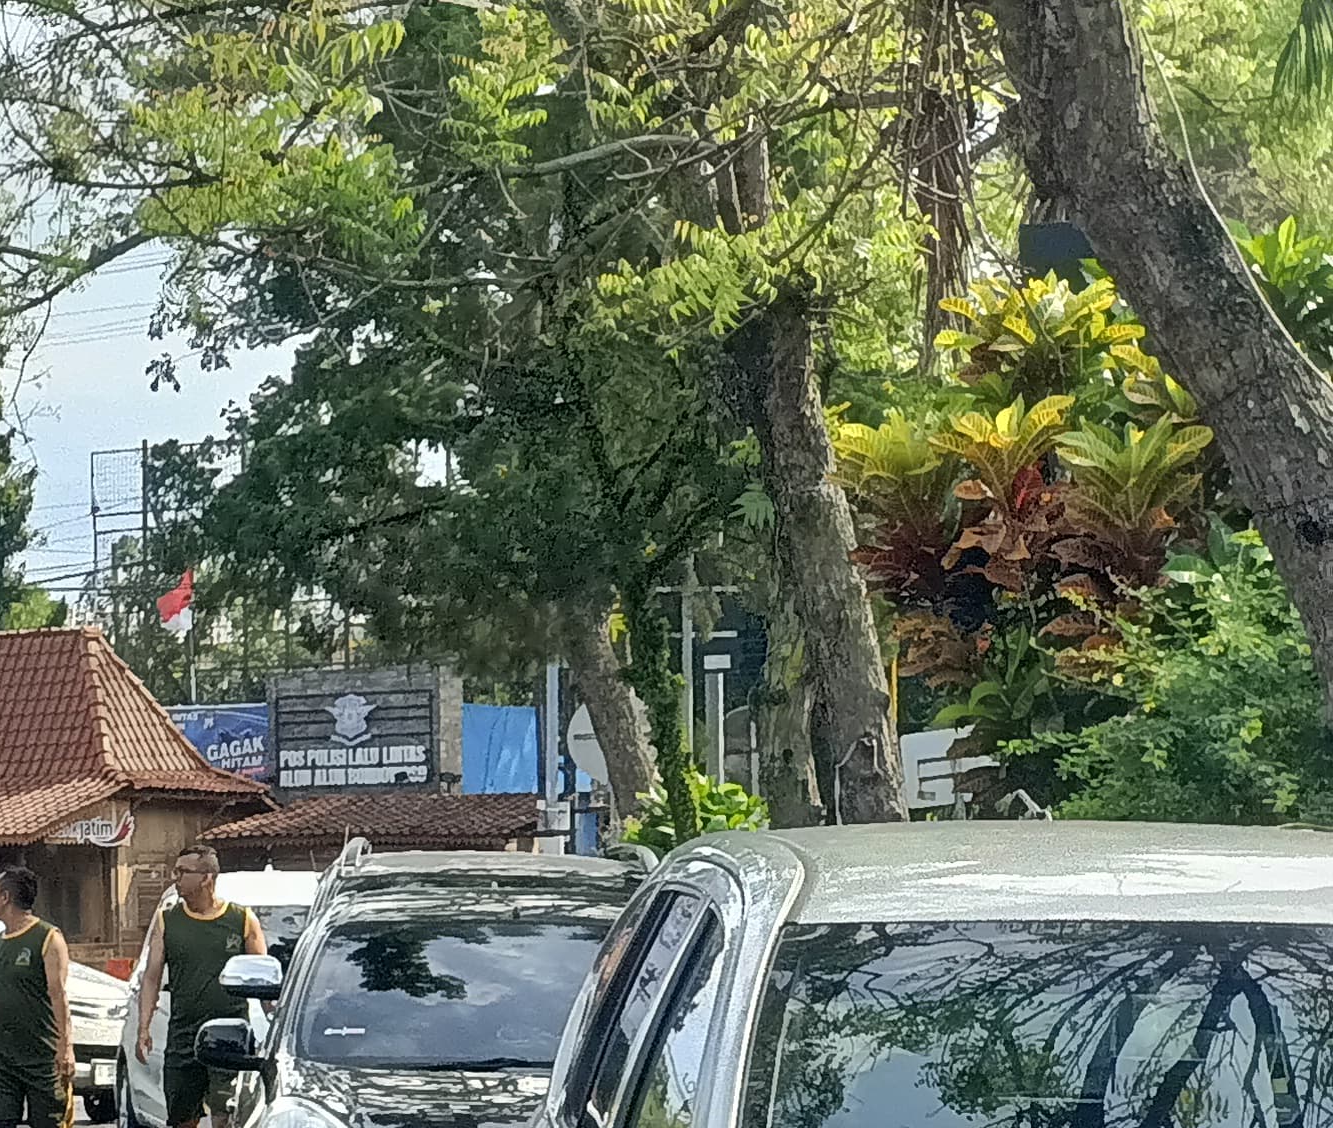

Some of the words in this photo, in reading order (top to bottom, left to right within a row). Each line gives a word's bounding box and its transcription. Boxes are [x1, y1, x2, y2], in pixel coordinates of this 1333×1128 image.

[206, 735, 264, 761] GAGAK
[279, 750, 305, 767] POS
[307, 748, 346, 766] POLISI
[348, 747, 379, 765] LALU
[221, 755, 263, 769] HITAM
